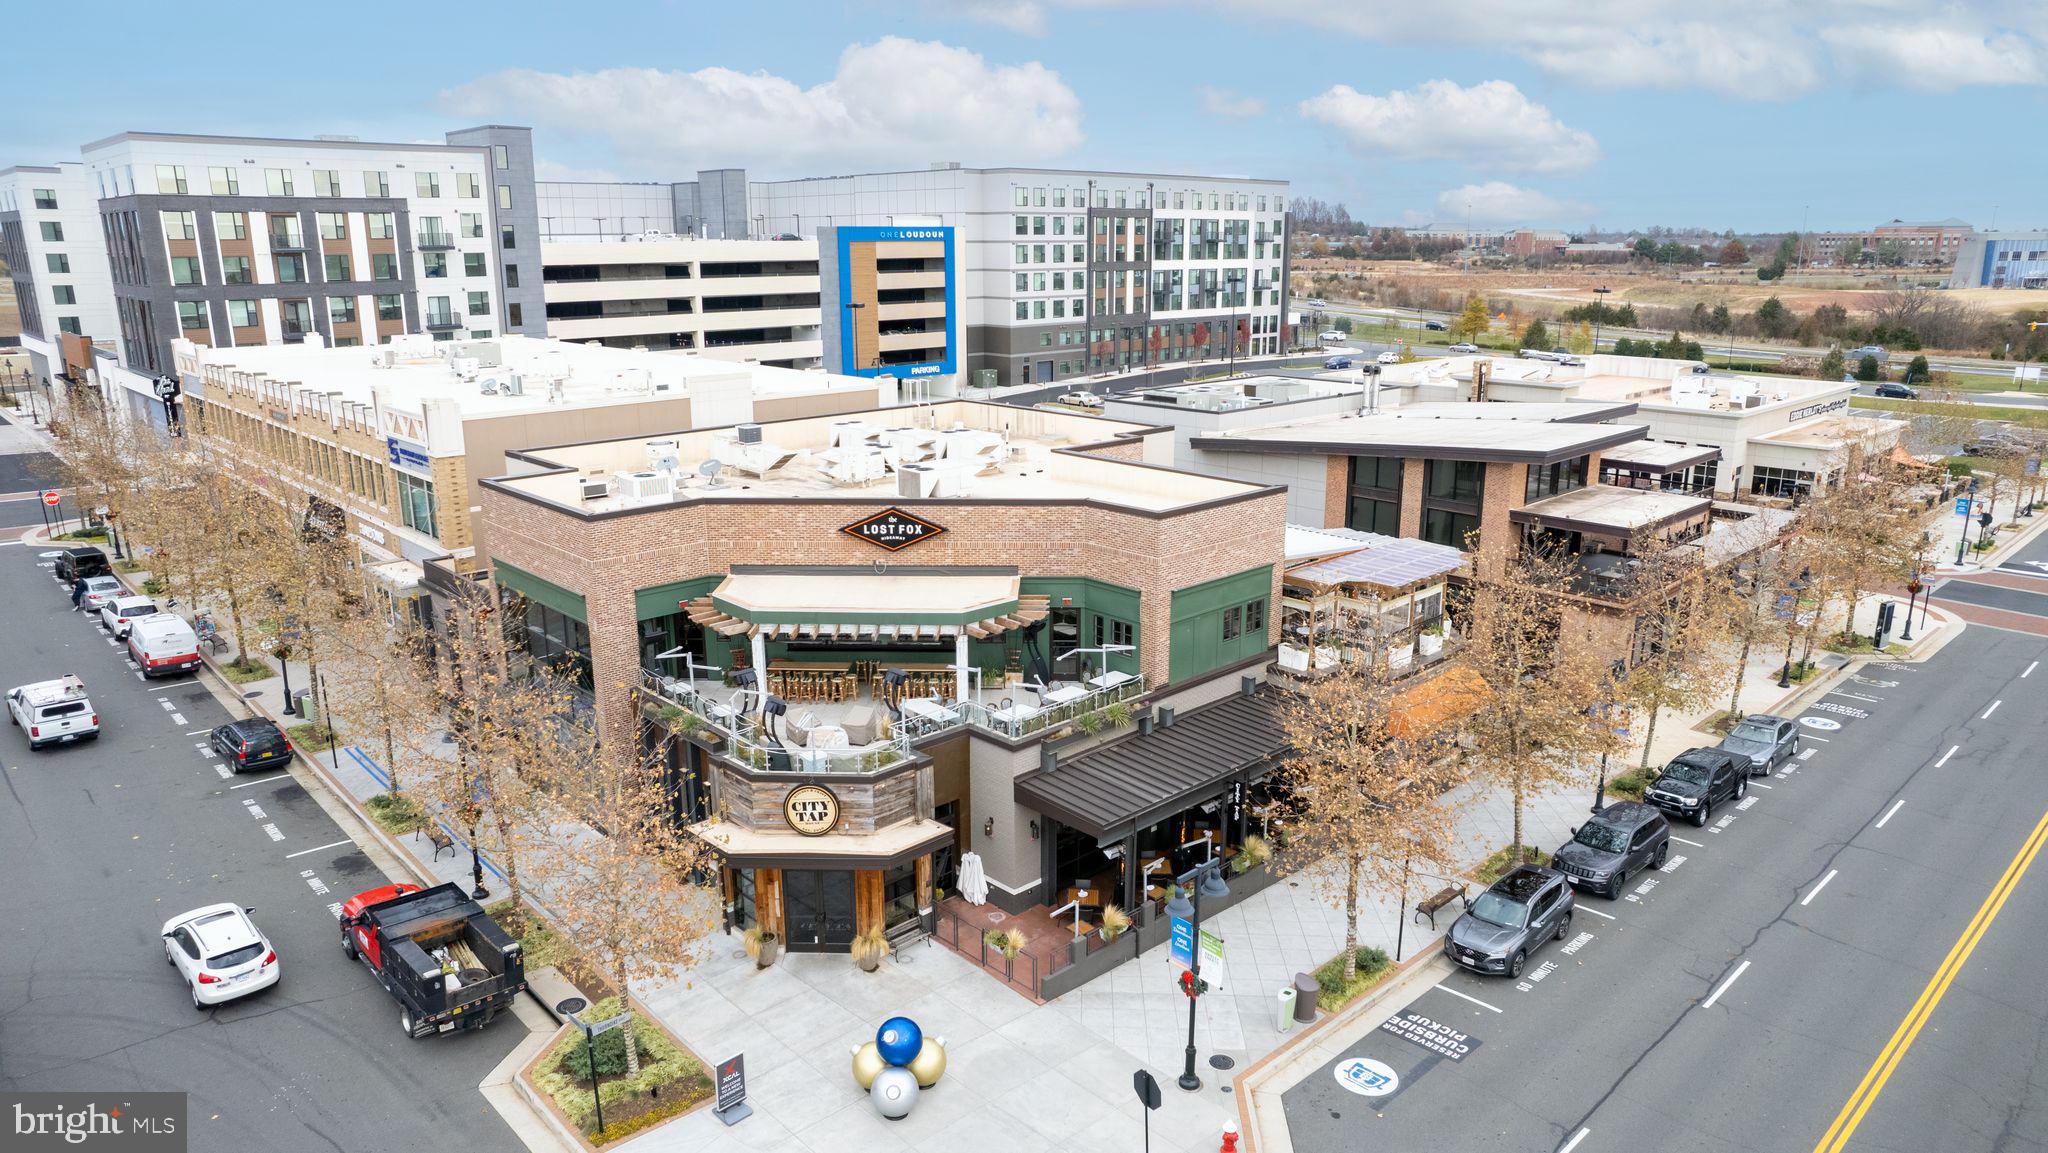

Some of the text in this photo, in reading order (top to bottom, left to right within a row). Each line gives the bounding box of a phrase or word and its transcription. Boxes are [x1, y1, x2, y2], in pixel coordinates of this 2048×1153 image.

[911, 365, 940, 375] PARKING
[863, 524, 923, 535] LOST FOX
[791, 801, 831, 811] CITY
[795, 811, 829, 822] TAP
[1515, 931, 1595, 992] 60 MINUTE PARKING
[1388, 1015, 1469, 1054] CURBSIDE
[1407, 1014, 1468, 1042] PICKUP
[1382, 1022, 1461, 1060] RESERVED FOR
